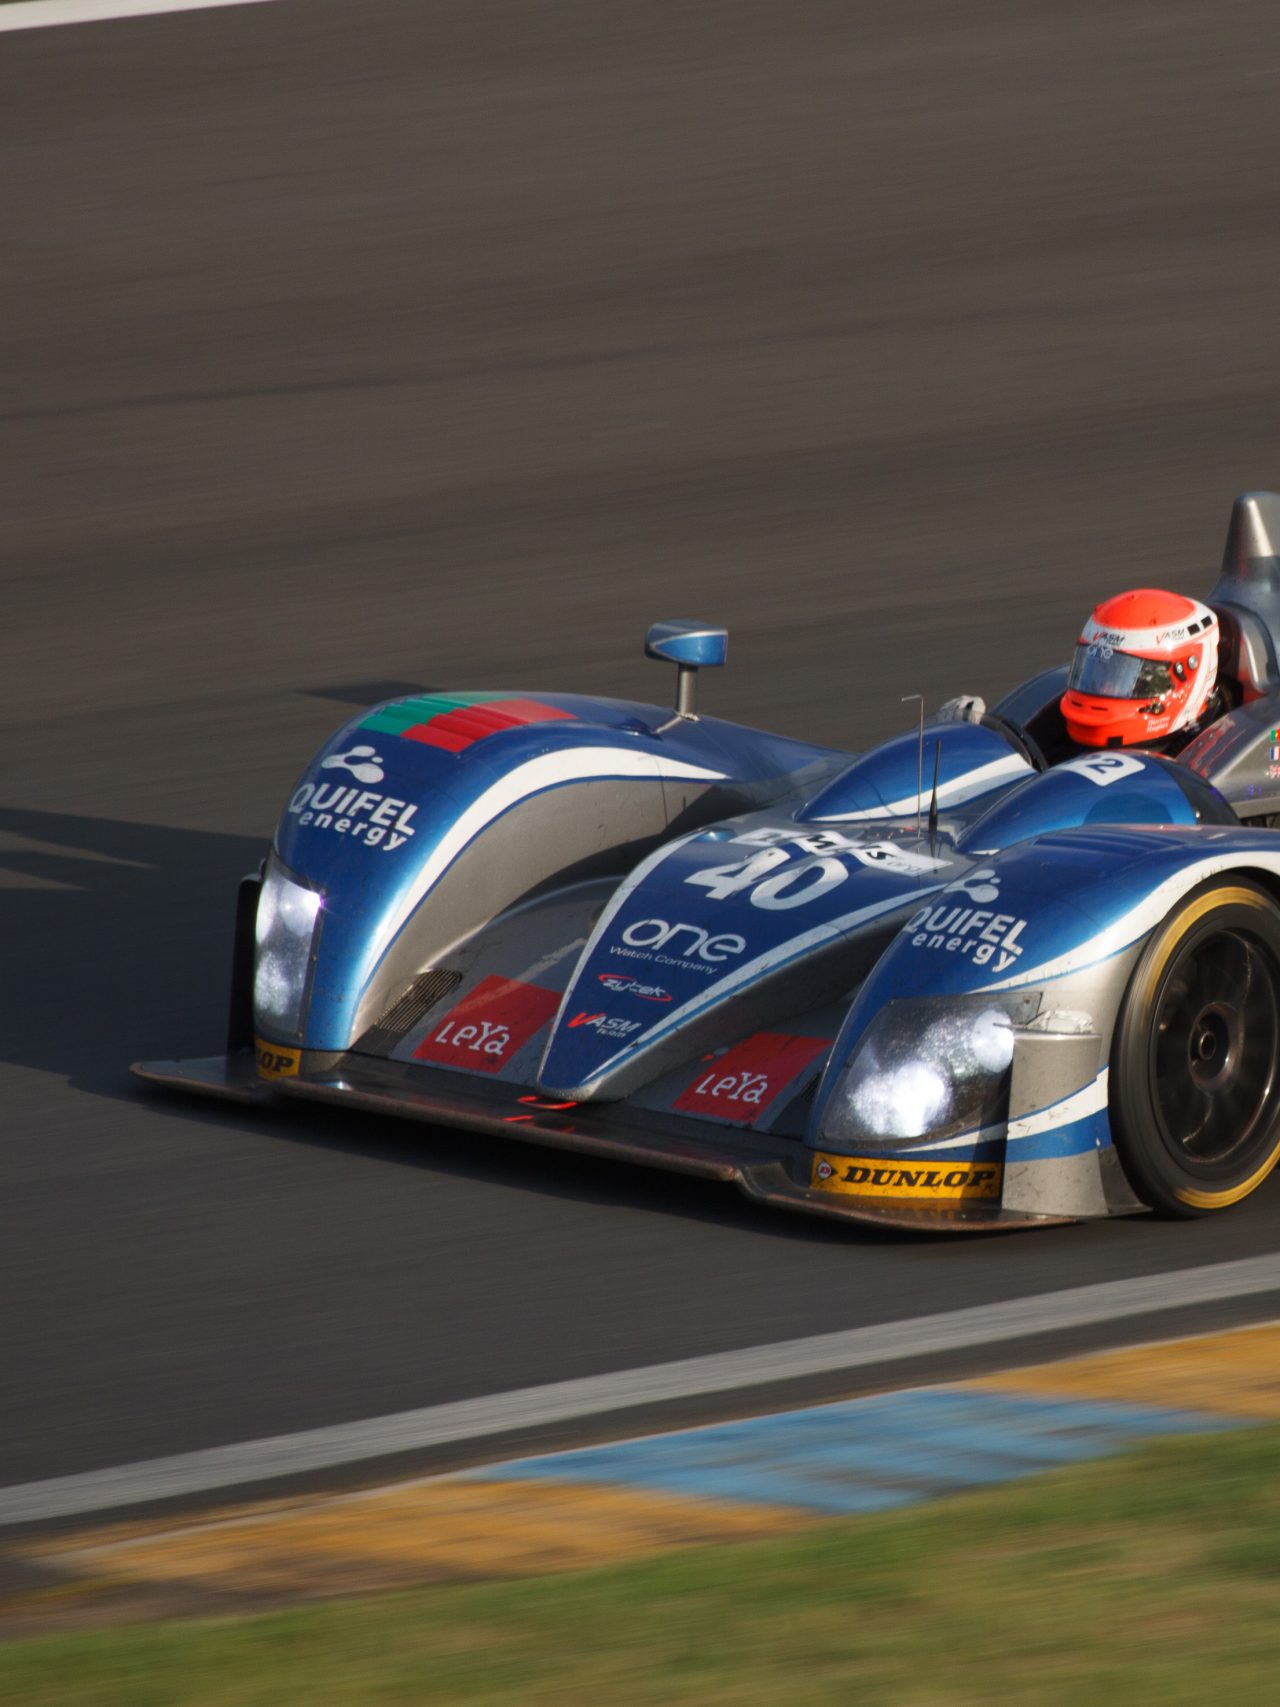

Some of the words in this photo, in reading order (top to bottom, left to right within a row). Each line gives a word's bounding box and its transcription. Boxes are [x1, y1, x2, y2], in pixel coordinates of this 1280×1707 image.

[288, 783, 419, 836] QUIFEL
[299, 811, 408, 851] energy
[684, 847, 849, 910] 40
[622, 919, 747, 962] one
[902, 905, 1028, 956] QUIFEL
[609, 945, 653, 962] Watch
[654, 954, 719, 976] Company
[911, 932, 1017, 973] energy
[841, 1166, 996, 1188] DUNLOP
